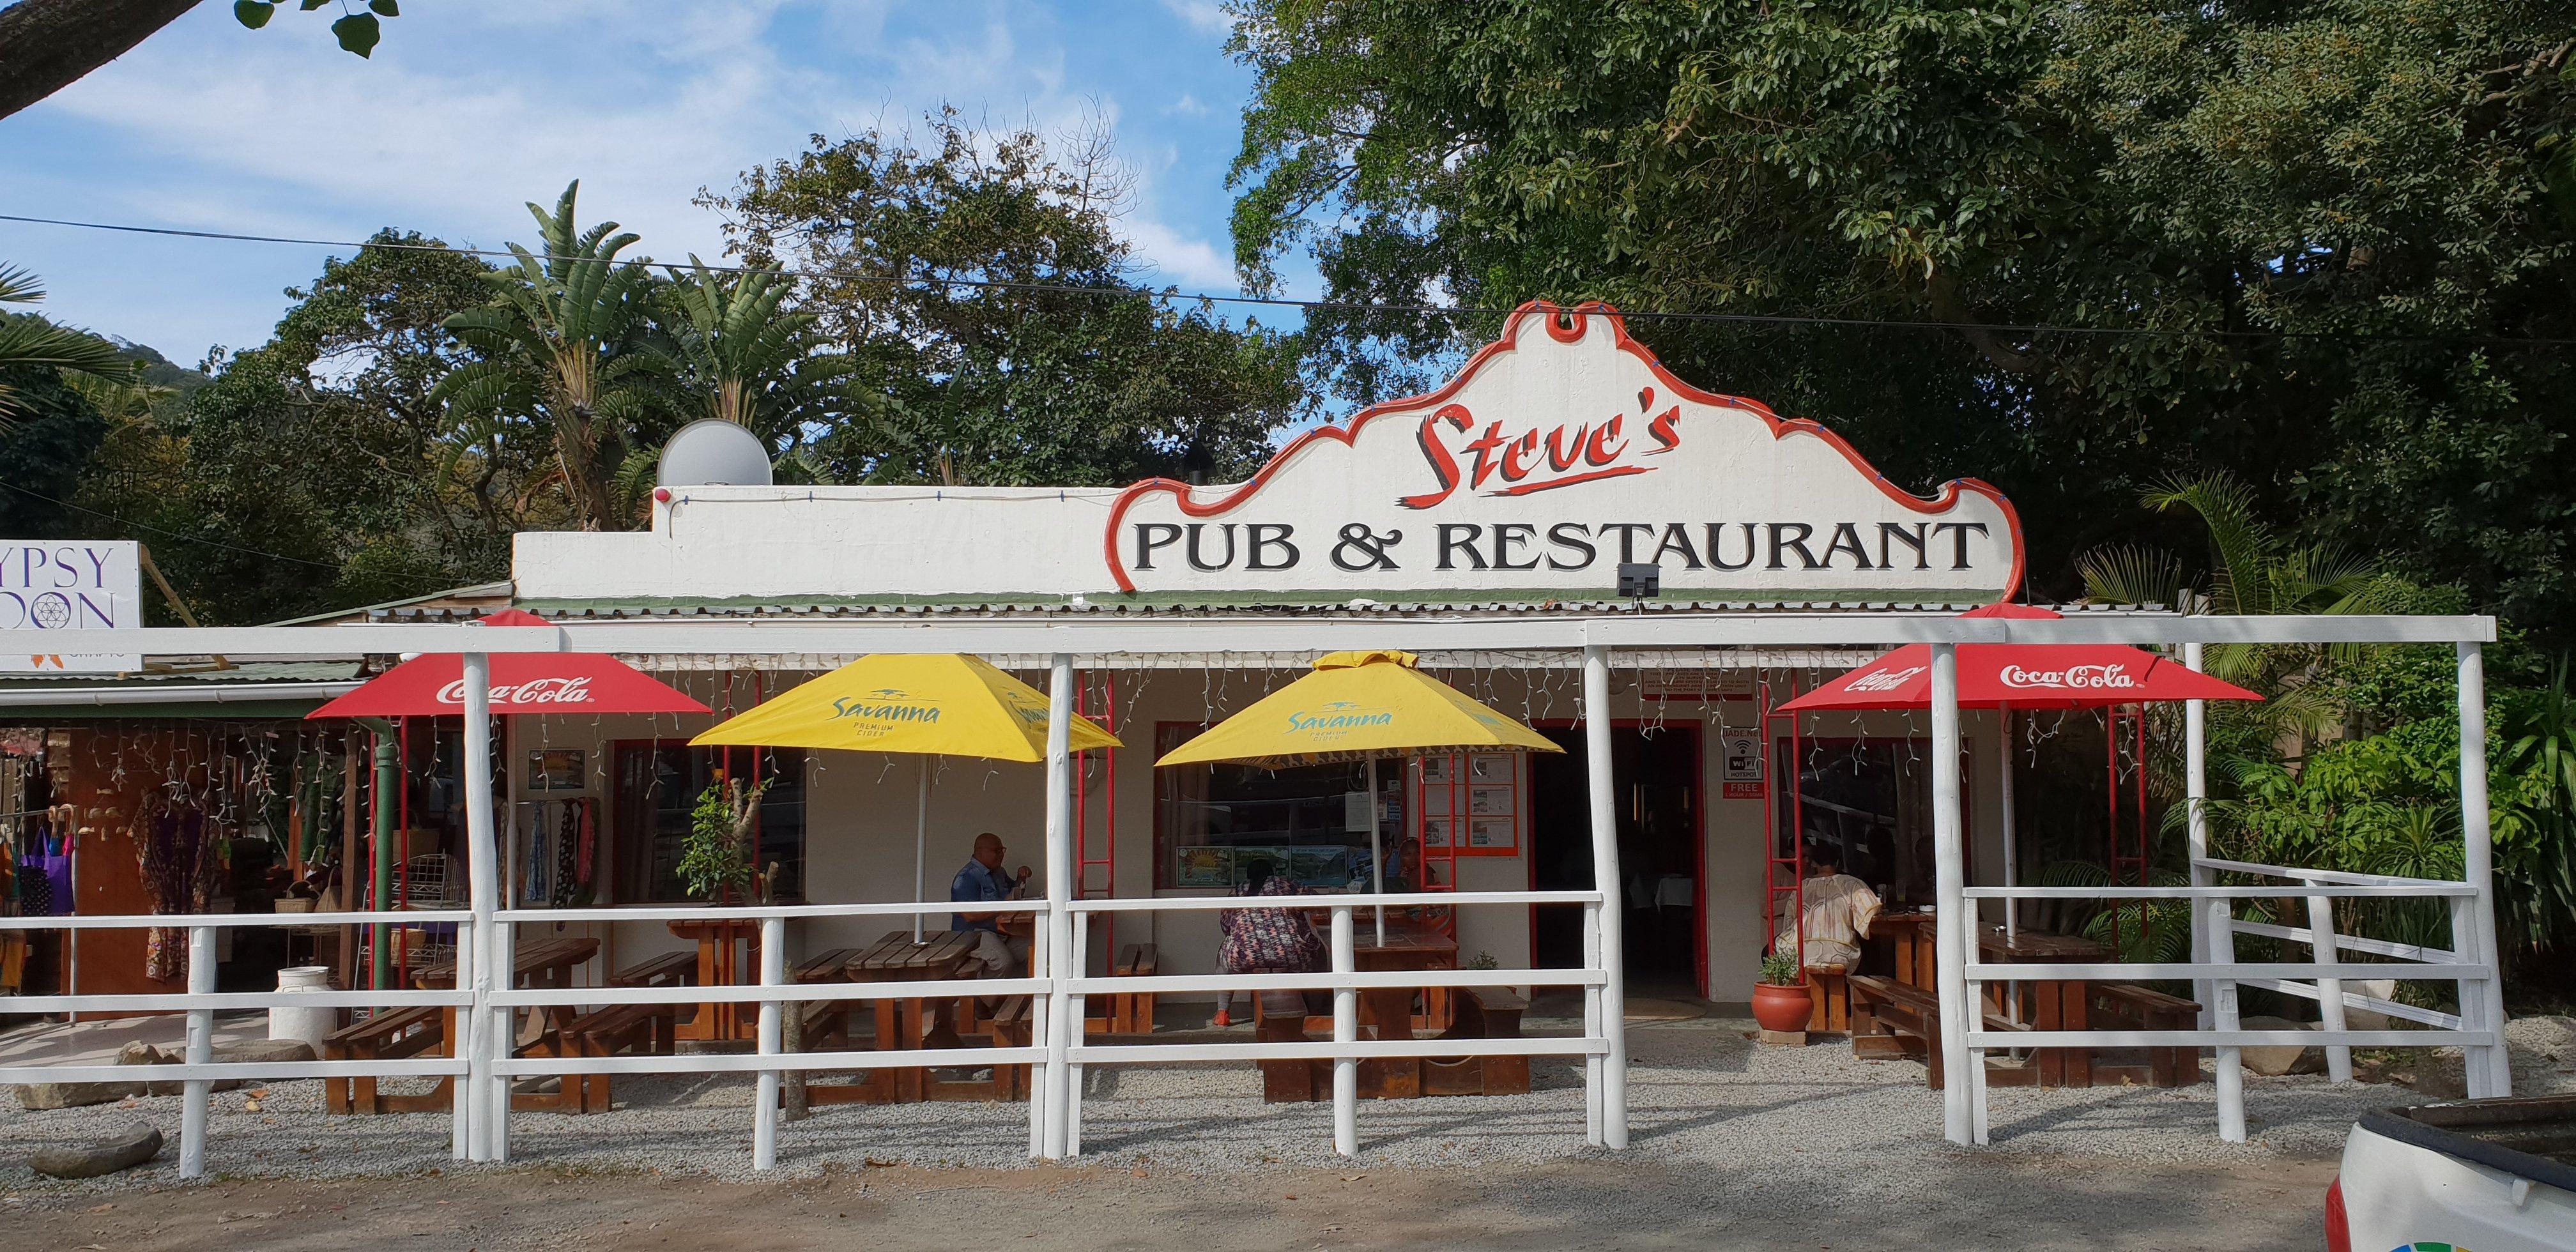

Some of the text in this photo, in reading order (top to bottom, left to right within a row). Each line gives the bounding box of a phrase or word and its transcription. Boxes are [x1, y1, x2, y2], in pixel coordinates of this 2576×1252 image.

[1395, 386, 1680, 510] Steve's
[1131, 521, 1991, 573] PUB & RESTAURANT
[2000, 664, 2135, 688] Coca-Cola
[436, 677, 592, 703] Coa-Cola
[824, 696, 940, 724] Savanna
[854, 722, 894, 731] PREMIUM
[1282, 711, 1392, 735] Savanna
[1731, 783, 1758, 791] FREE
